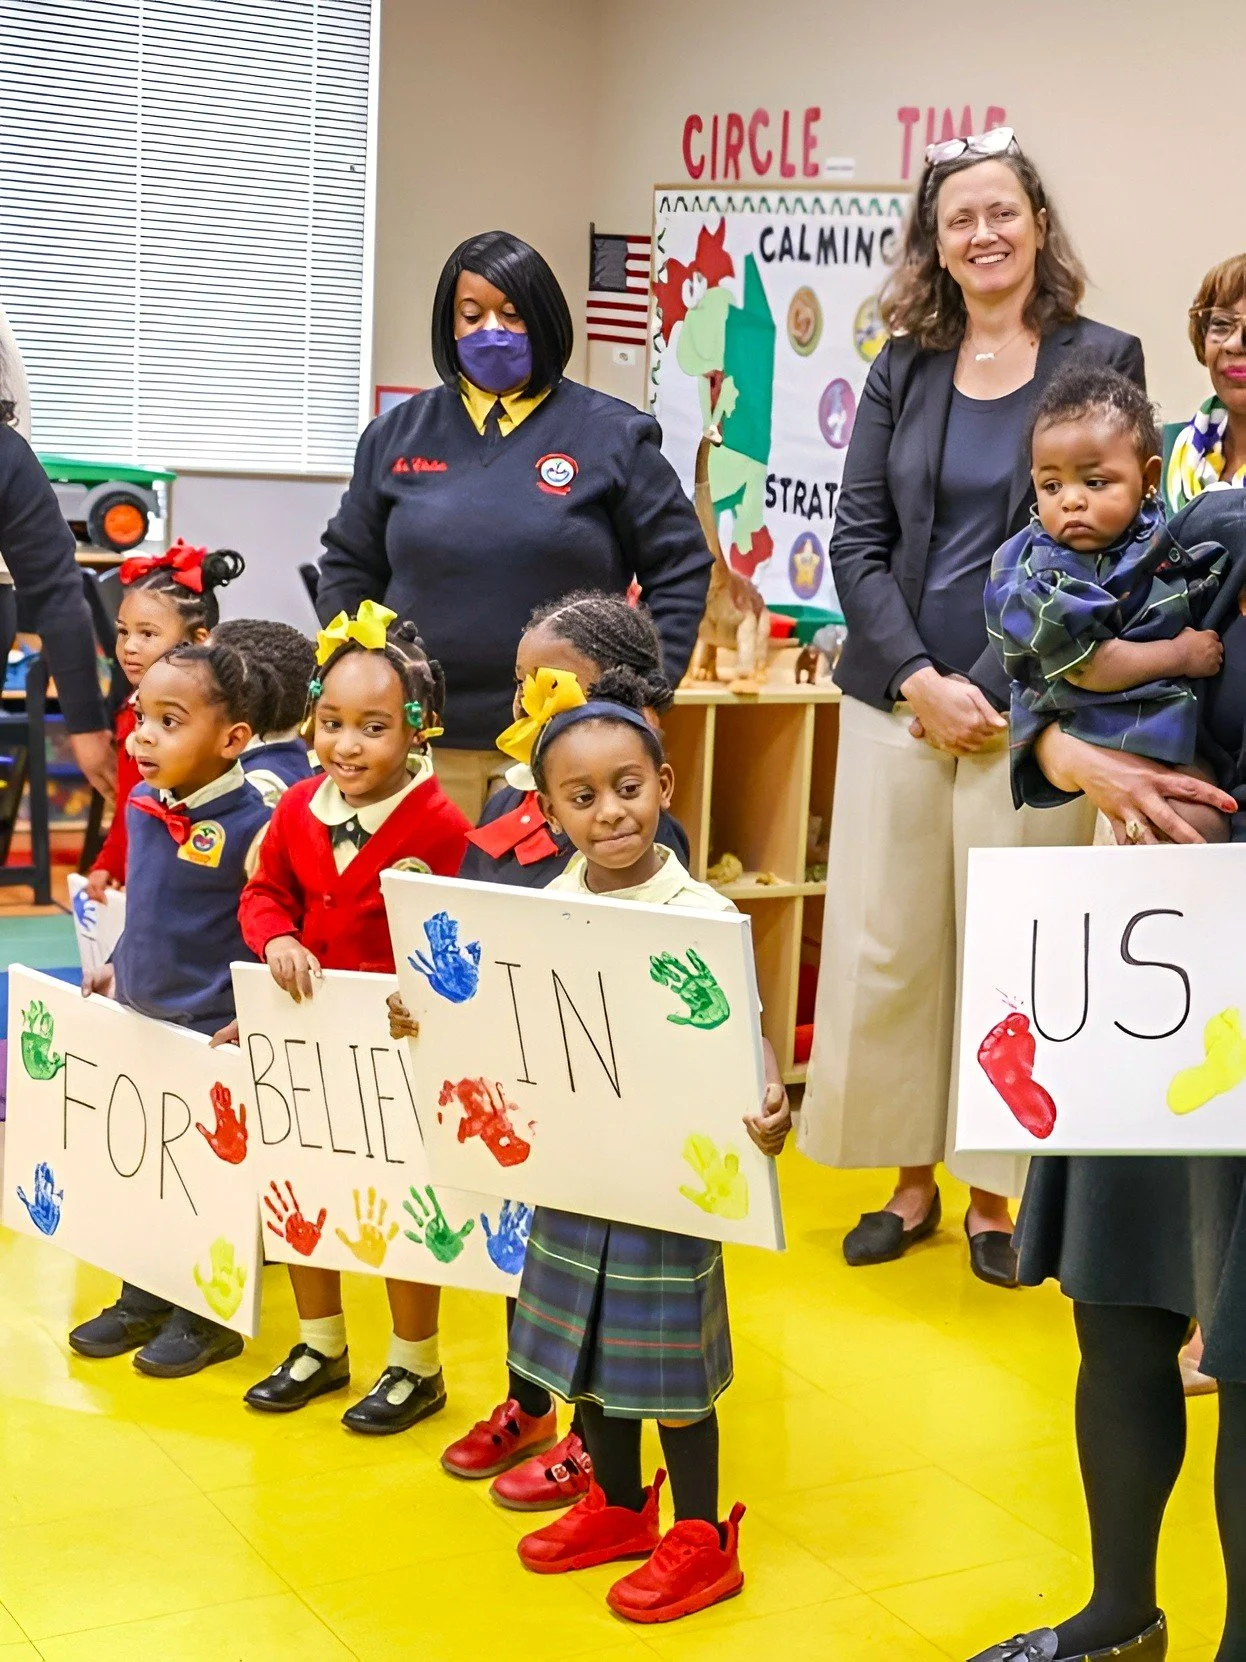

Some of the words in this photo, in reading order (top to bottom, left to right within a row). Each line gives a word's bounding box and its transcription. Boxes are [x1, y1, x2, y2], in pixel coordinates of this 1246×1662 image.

[682, 106, 821, 181] CIRCLE
[494, 961, 621, 1098] IN
[1031, 908, 1191, 1042] US
[64, 1052, 198, 1216] FOR
